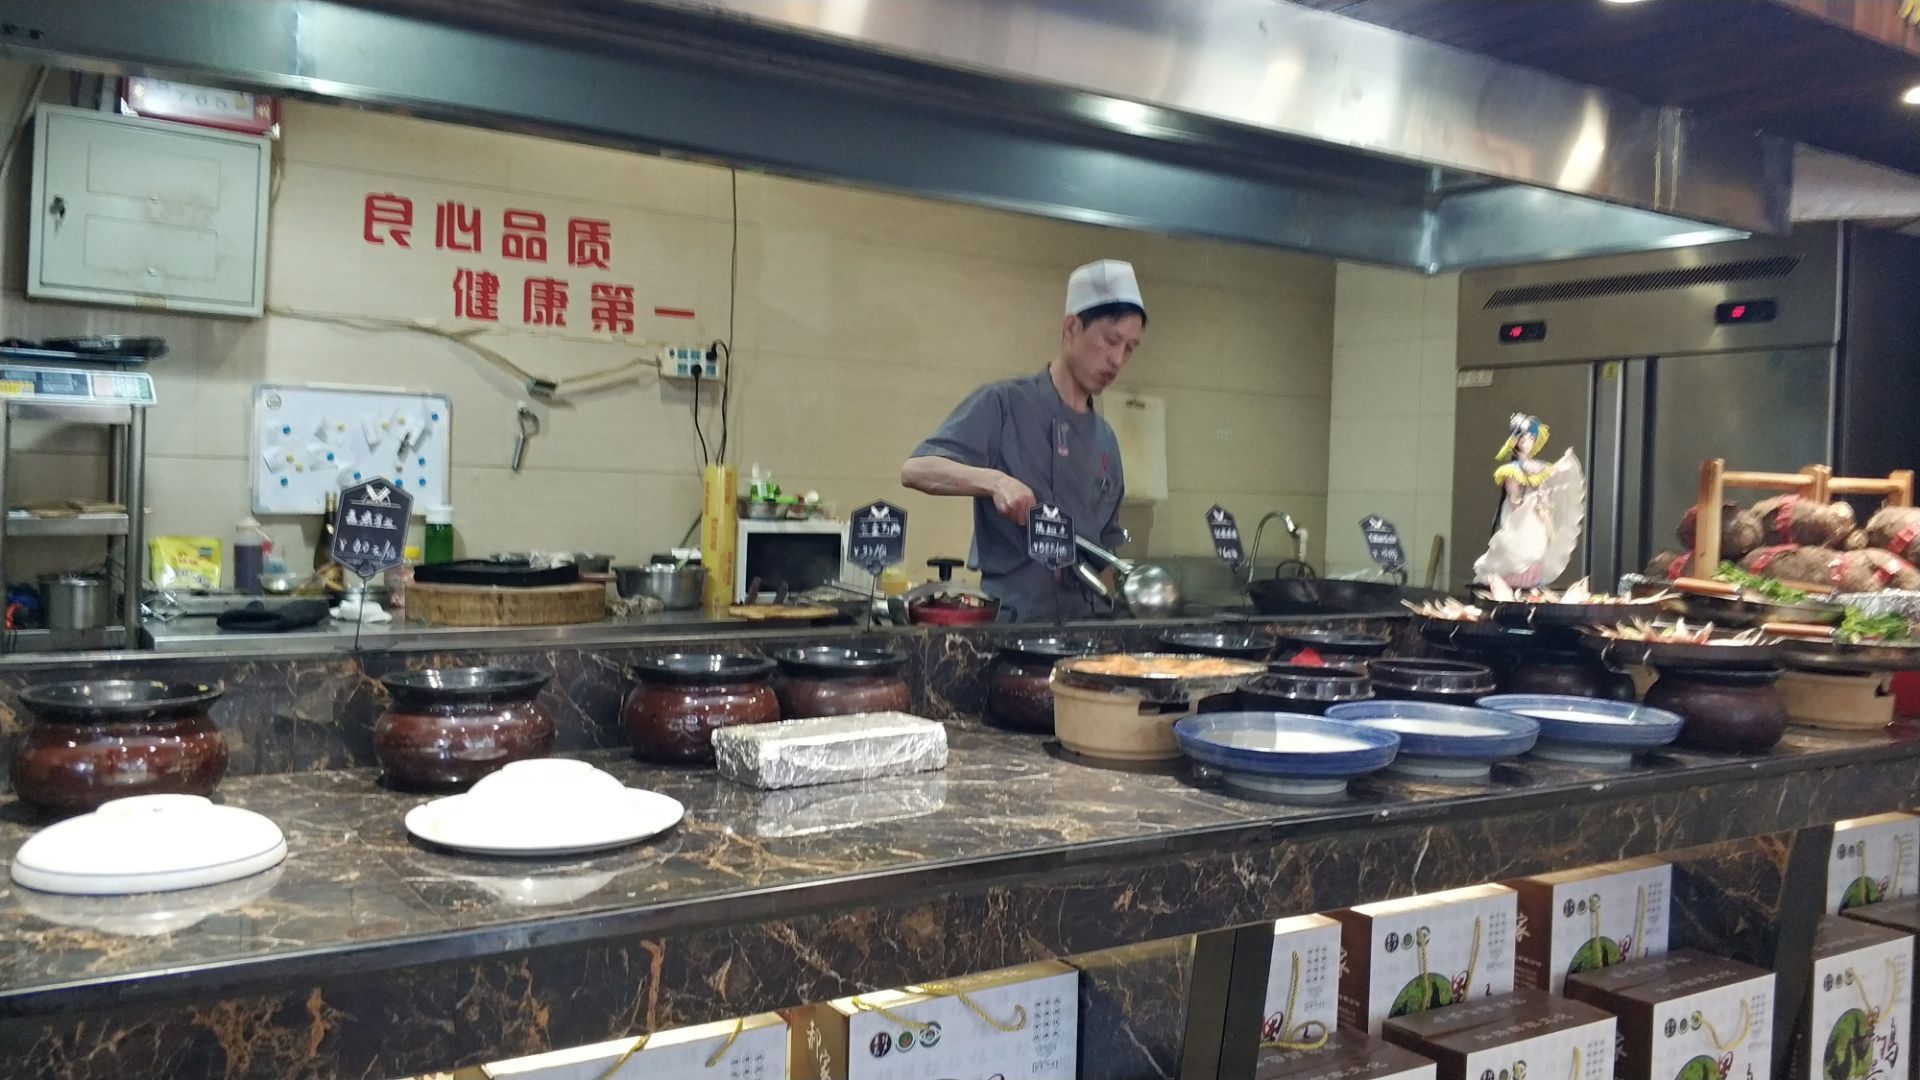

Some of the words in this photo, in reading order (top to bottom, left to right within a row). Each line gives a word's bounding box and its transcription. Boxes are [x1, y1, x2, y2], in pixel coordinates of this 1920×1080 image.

[364, 192, 612, 269] 良心品质
[453, 267, 695, 334] 健康第一
